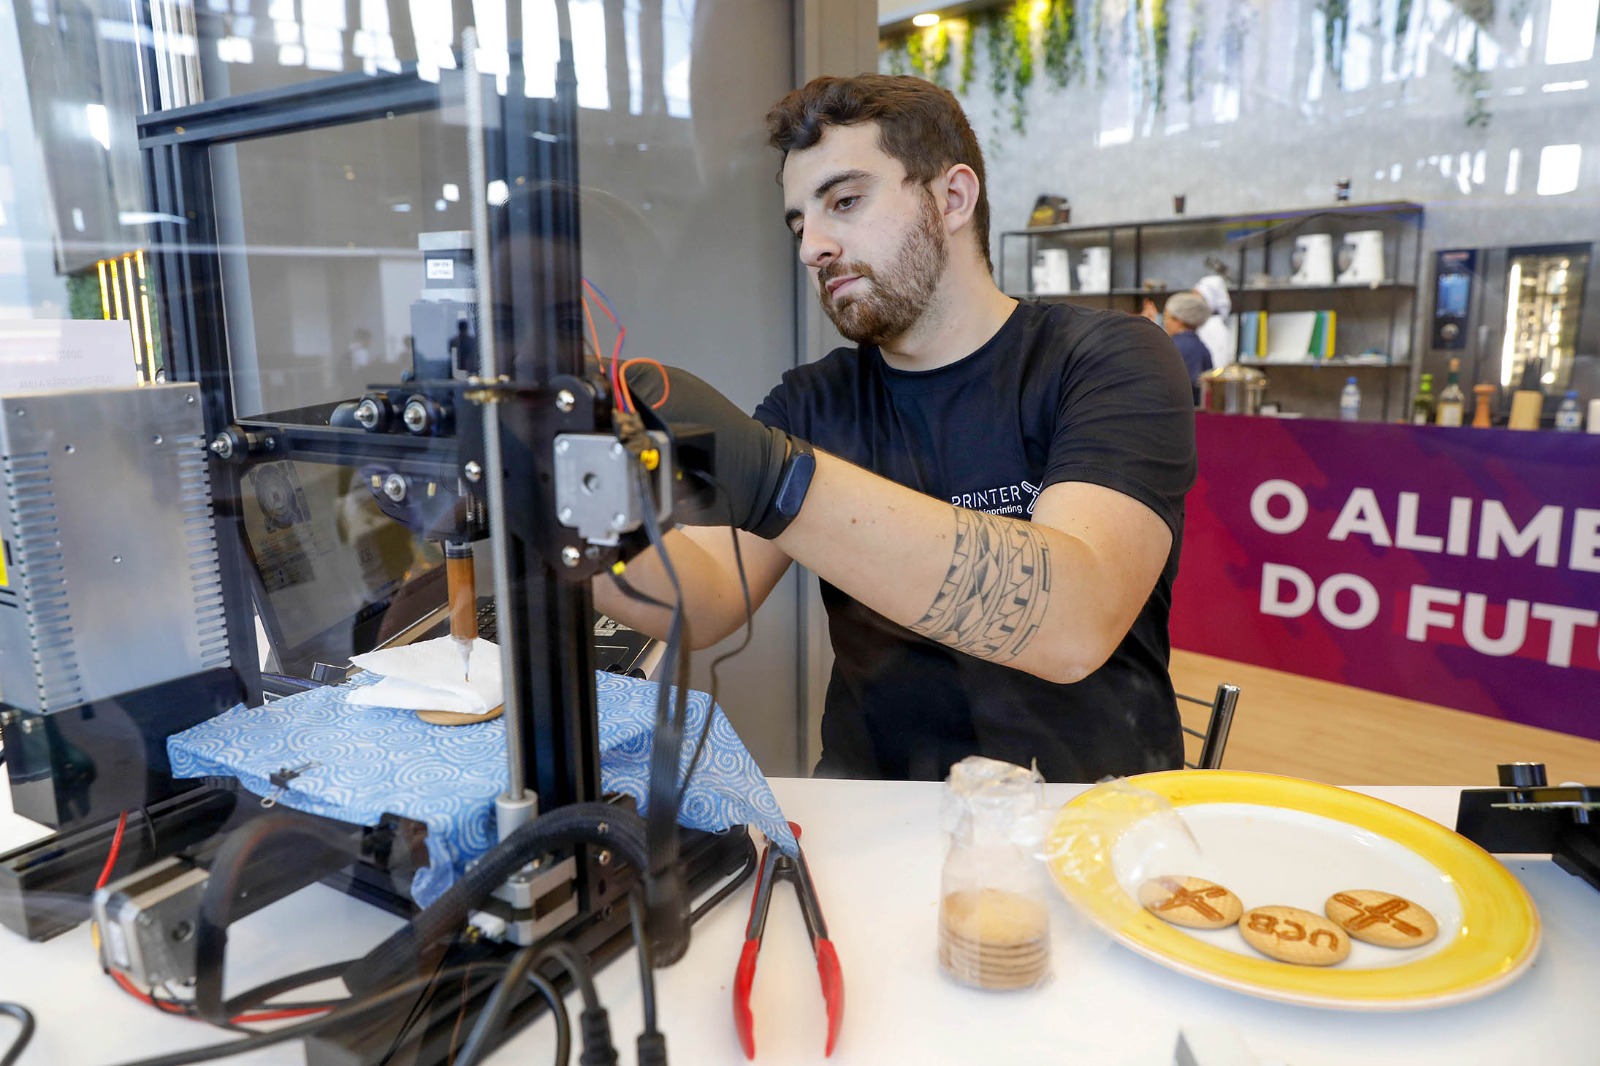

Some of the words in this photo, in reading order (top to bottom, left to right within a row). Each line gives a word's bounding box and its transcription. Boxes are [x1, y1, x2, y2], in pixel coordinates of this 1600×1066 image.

[951, 485, 1022, 509] PRINTER
[979, 504, 1023, 516] ioprinting
[1250, 479, 1309, 535] O
[1327, 487, 1600, 573] ALIME
[1259, 562, 1380, 630] DO
[1406, 584, 1600, 668] FUT
[1247, 912, 1339, 953] UCB
